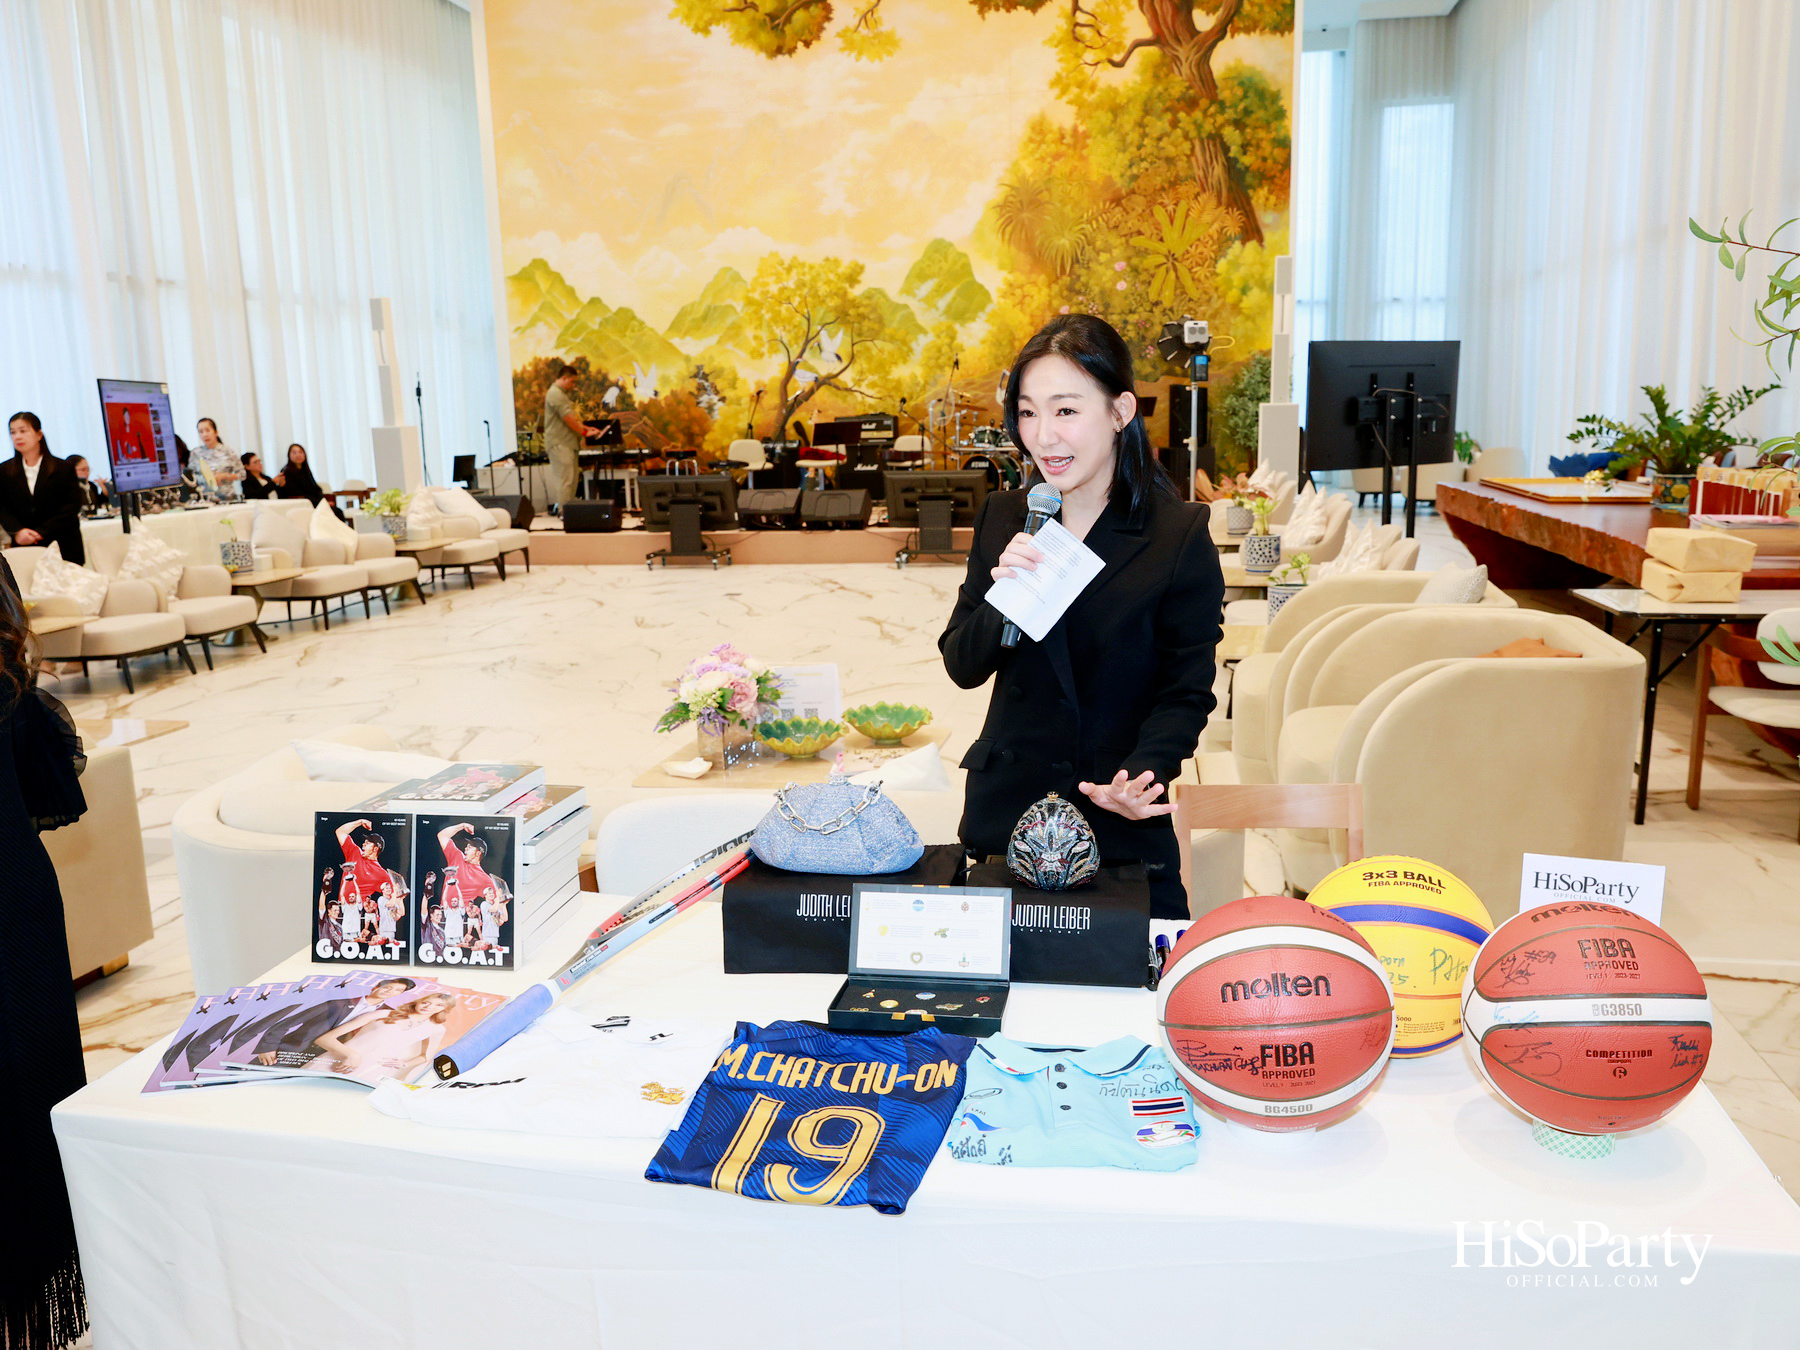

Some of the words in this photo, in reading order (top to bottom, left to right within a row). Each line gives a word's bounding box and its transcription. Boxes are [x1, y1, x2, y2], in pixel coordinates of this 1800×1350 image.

[1362, 870, 1398, 881] 3x3
[1403, 871, 1446, 889] BALL
[1393, 881, 1442, 895] APPROVED
[1533, 871, 1640, 904] HiSoParty
[796, 893, 833, 917] JUDITH
[835, 895, 851, 918] LEI
[1530, 903, 1641, 923] molten
[1011, 904, 1051, 928] JUDITH
[1053, 905, 1091, 930] LEIBER
[1577, 938, 1636, 959] FIBA
[1583, 961, 1639, 971] APPROVED
[1220, 972, 1332, 1003] molten
[1591, 1003, 1643, 1016] BG3850
[1260, 1042, 1315, 1068] FIBA
[1585, 1049, 1653, 1058] COMPETITION
[711, 1043, 959, 1095] M.CHATCHU-ON
[1261, 1068, 1316, 1079] APPROVED
[1264, 1104, 1314, 1114] BG4500
[711, 1092, 886, 1206] 19
